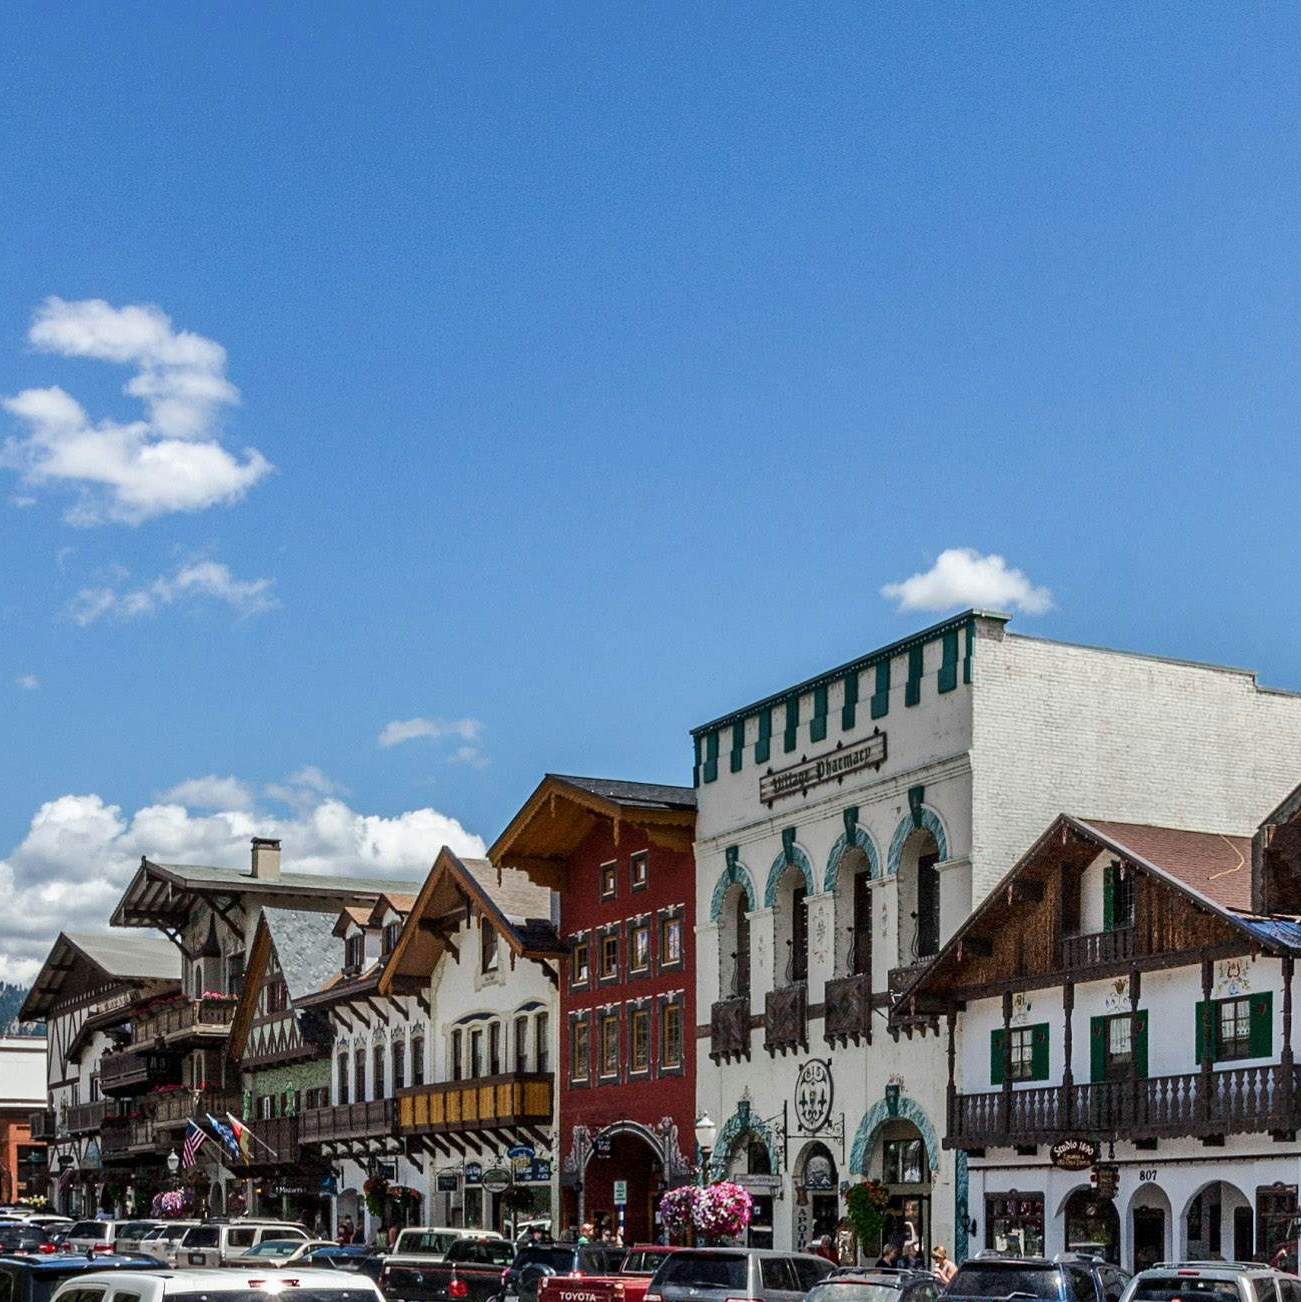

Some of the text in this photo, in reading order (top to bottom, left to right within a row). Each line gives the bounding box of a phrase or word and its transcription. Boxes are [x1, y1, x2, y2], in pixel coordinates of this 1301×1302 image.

[816, 746, 872, 780] Pharmacy
[1053, 1140, 1077, 1157] Studio
[1139, 1170, 1157, 1181] 807
[559, 1291, 596, 1302] TOYOTA
